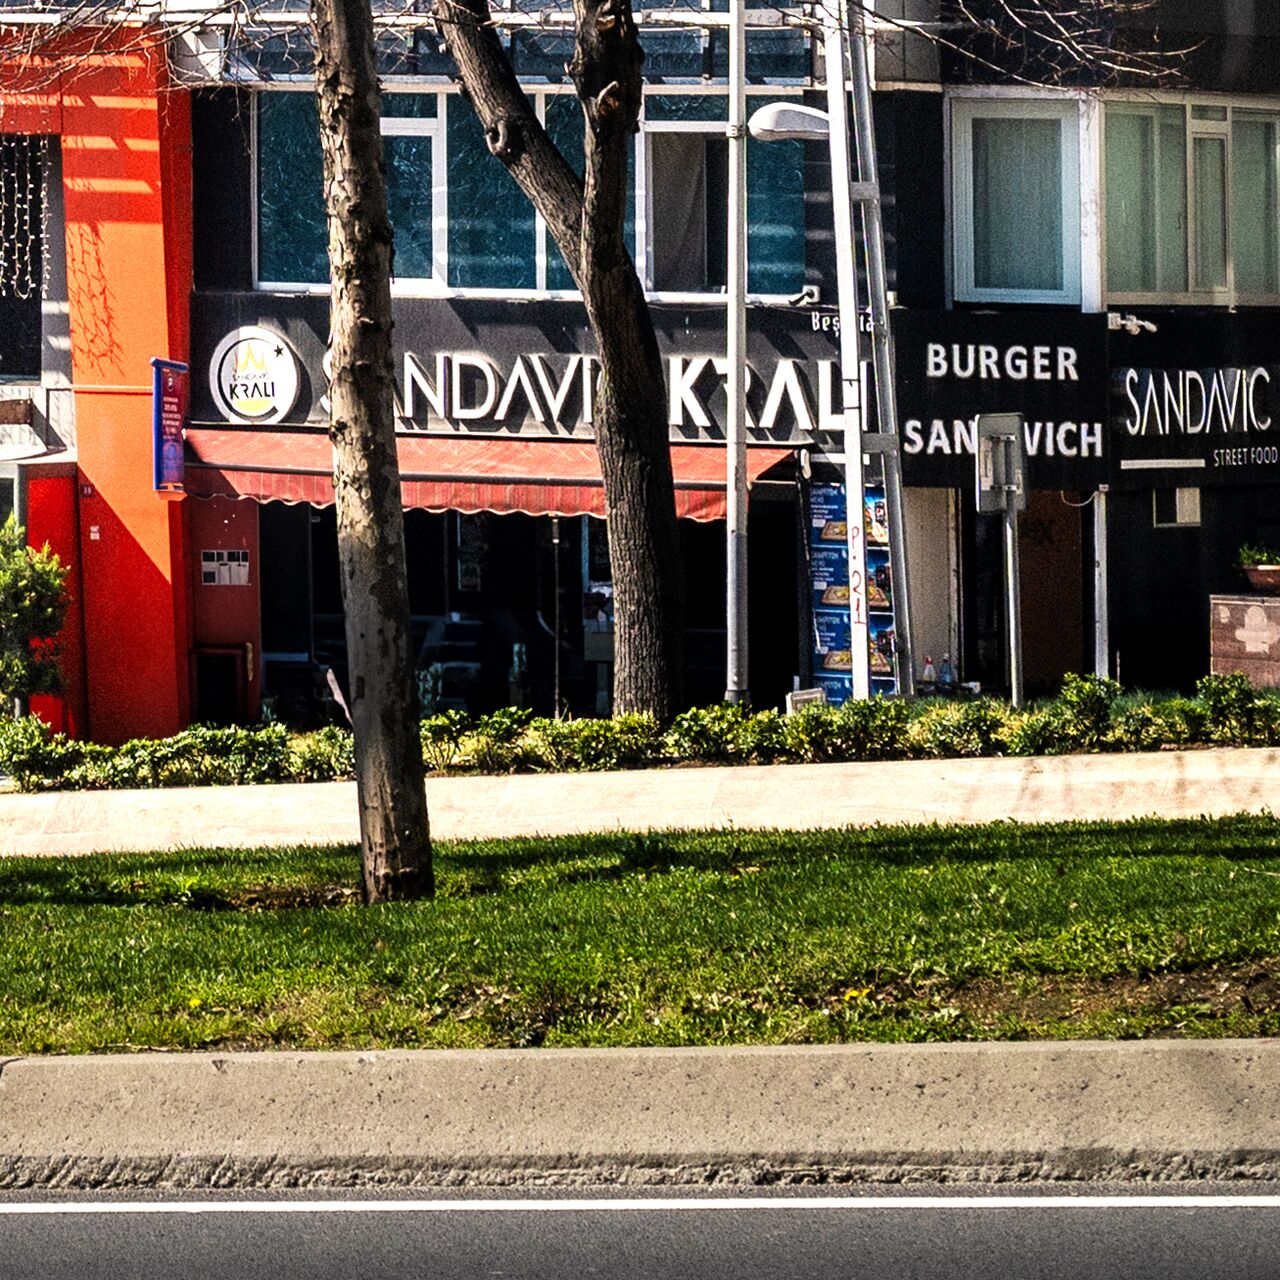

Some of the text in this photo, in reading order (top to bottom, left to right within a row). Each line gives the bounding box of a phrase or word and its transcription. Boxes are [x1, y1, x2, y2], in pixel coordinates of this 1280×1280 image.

[927, 342, 1079, 381] BURGER
[229, 381, 276, 401] KRALI
[1213, 445, 1279, 468] STREET FOOD
